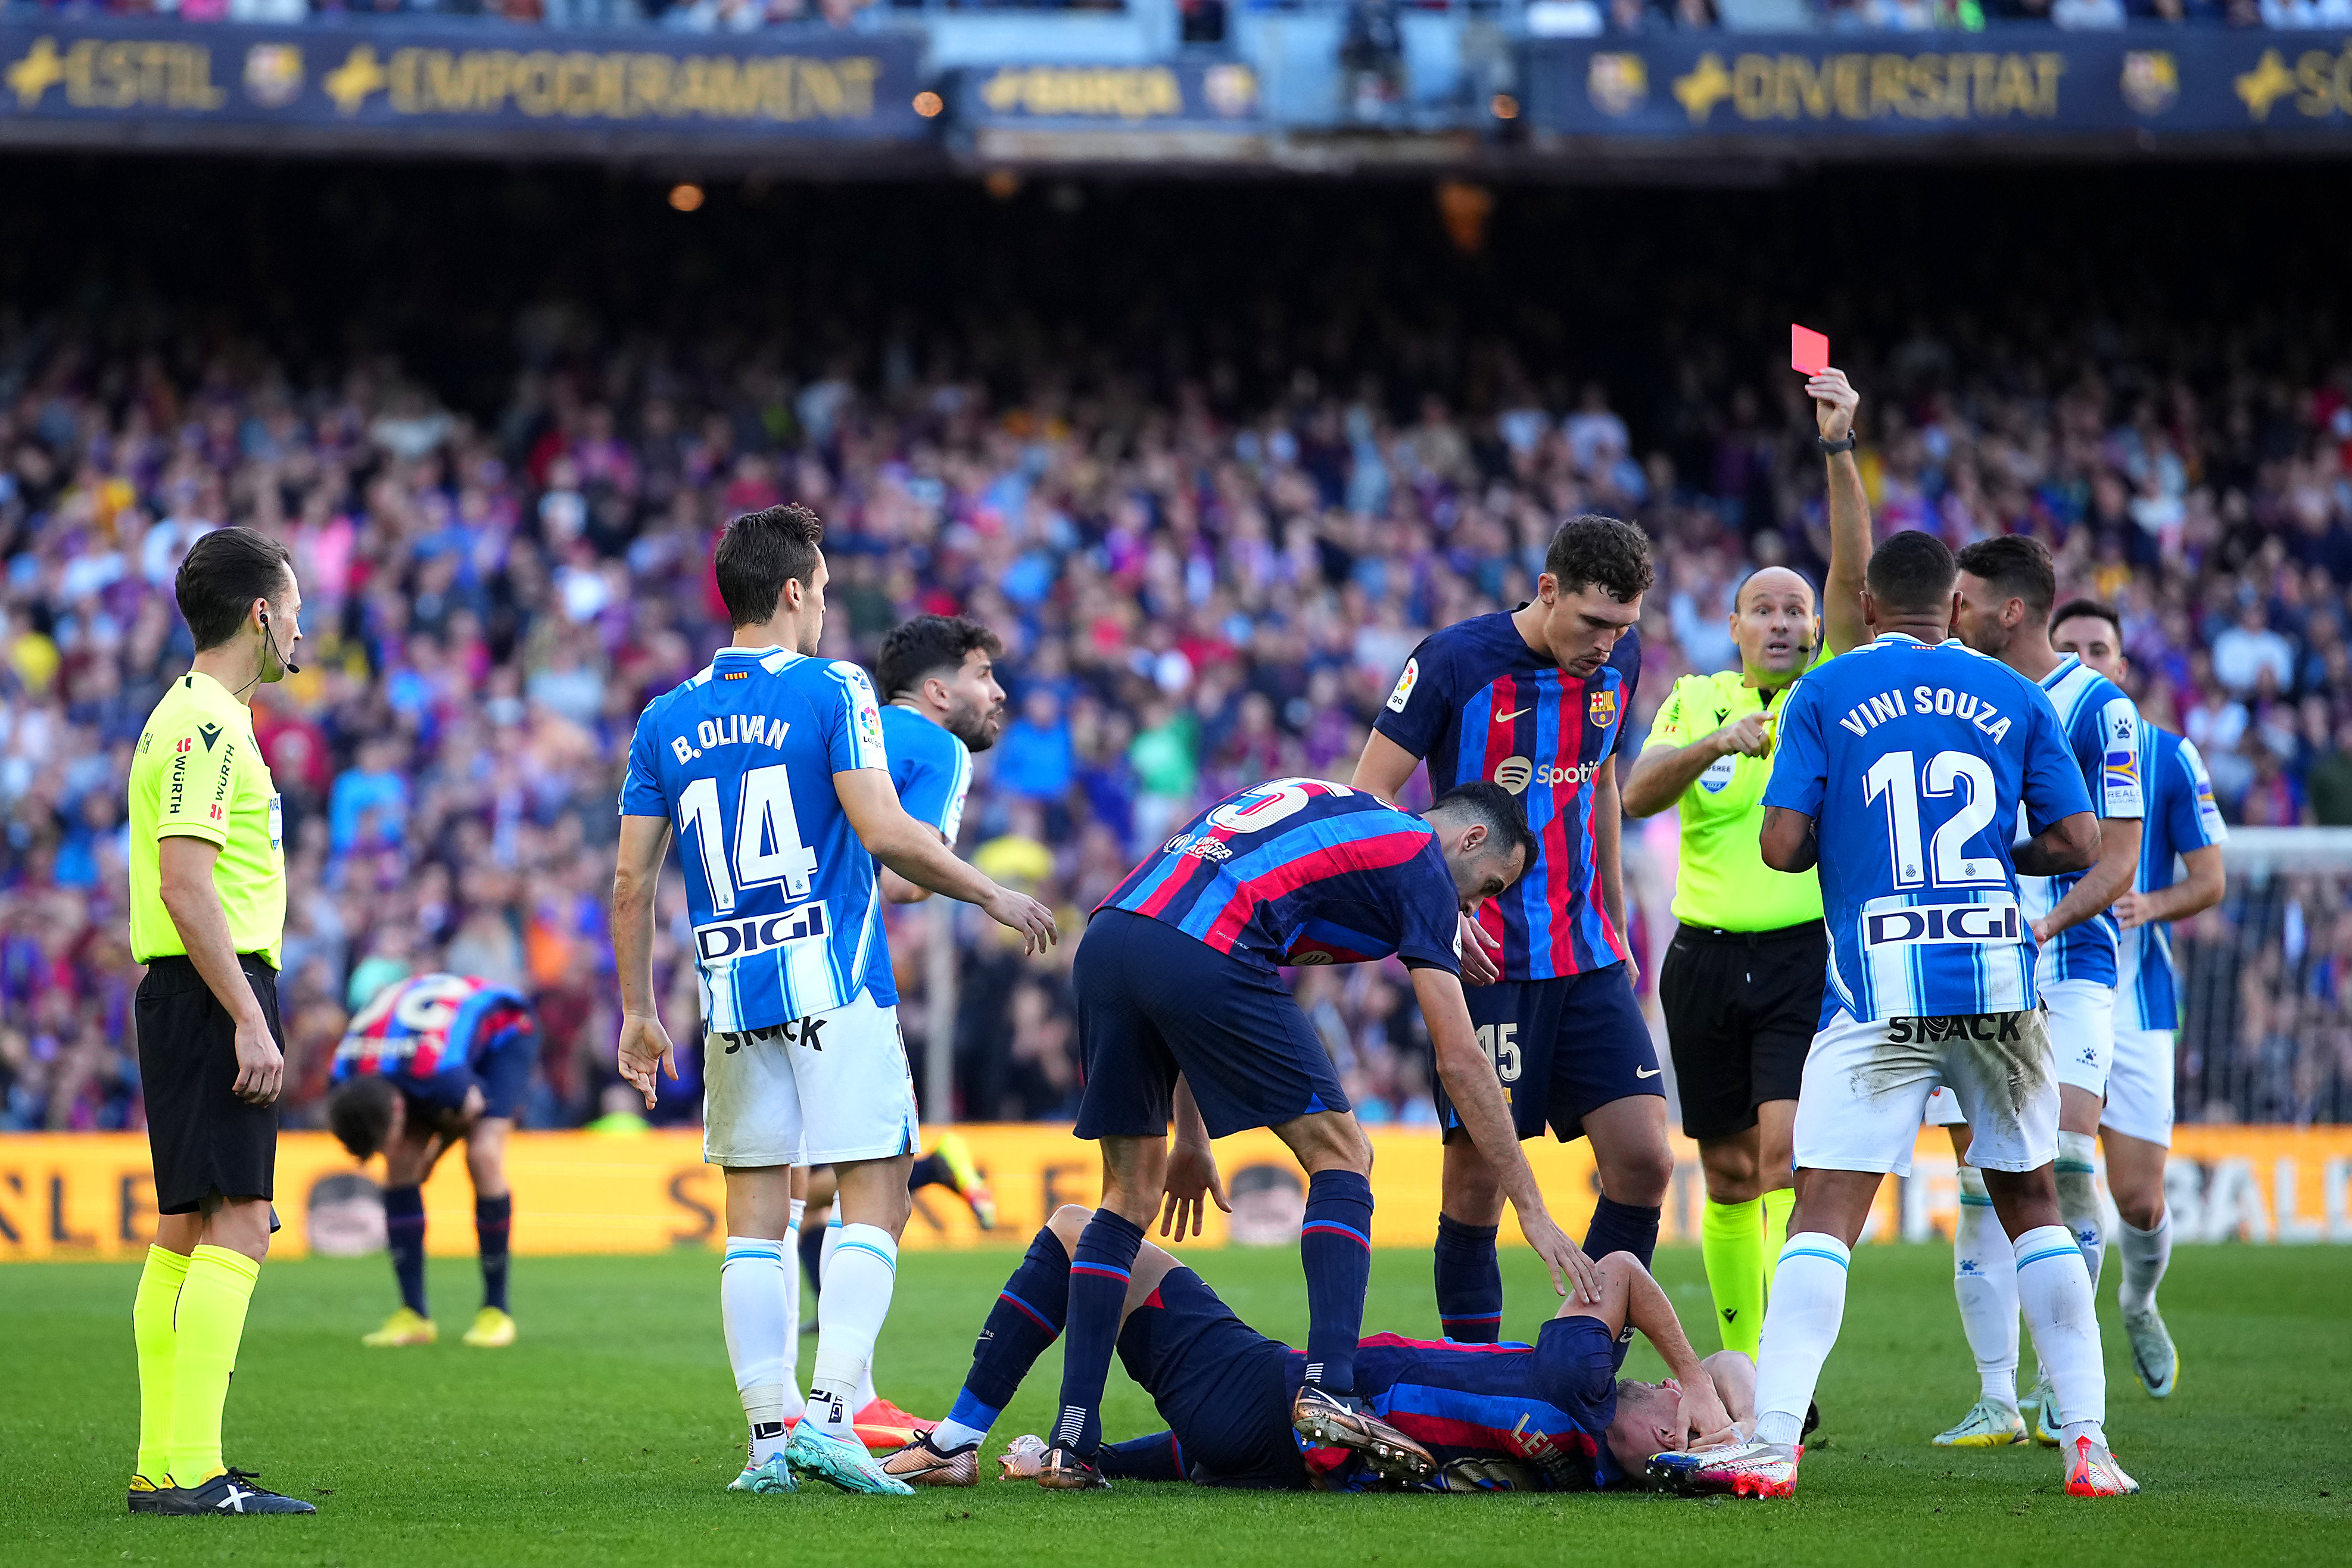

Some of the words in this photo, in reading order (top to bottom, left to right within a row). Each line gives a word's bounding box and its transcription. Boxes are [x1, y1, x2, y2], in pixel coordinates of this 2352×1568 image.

[1839, 689, 1908, 738] VINI
[1914, 685, 2012, 745] SOUZA
[170, 755, 186, 814] WÜRTH
[215, 743, 235, 802] WÜRTH
[1206, 777, 1355, 834] 5
[1862, 750, 2007, 890] 12
[677, 763, 819, 916] 14
[697, 906, 824, 961] DIGI
[1868, 908, 2017, 946] DIGI
